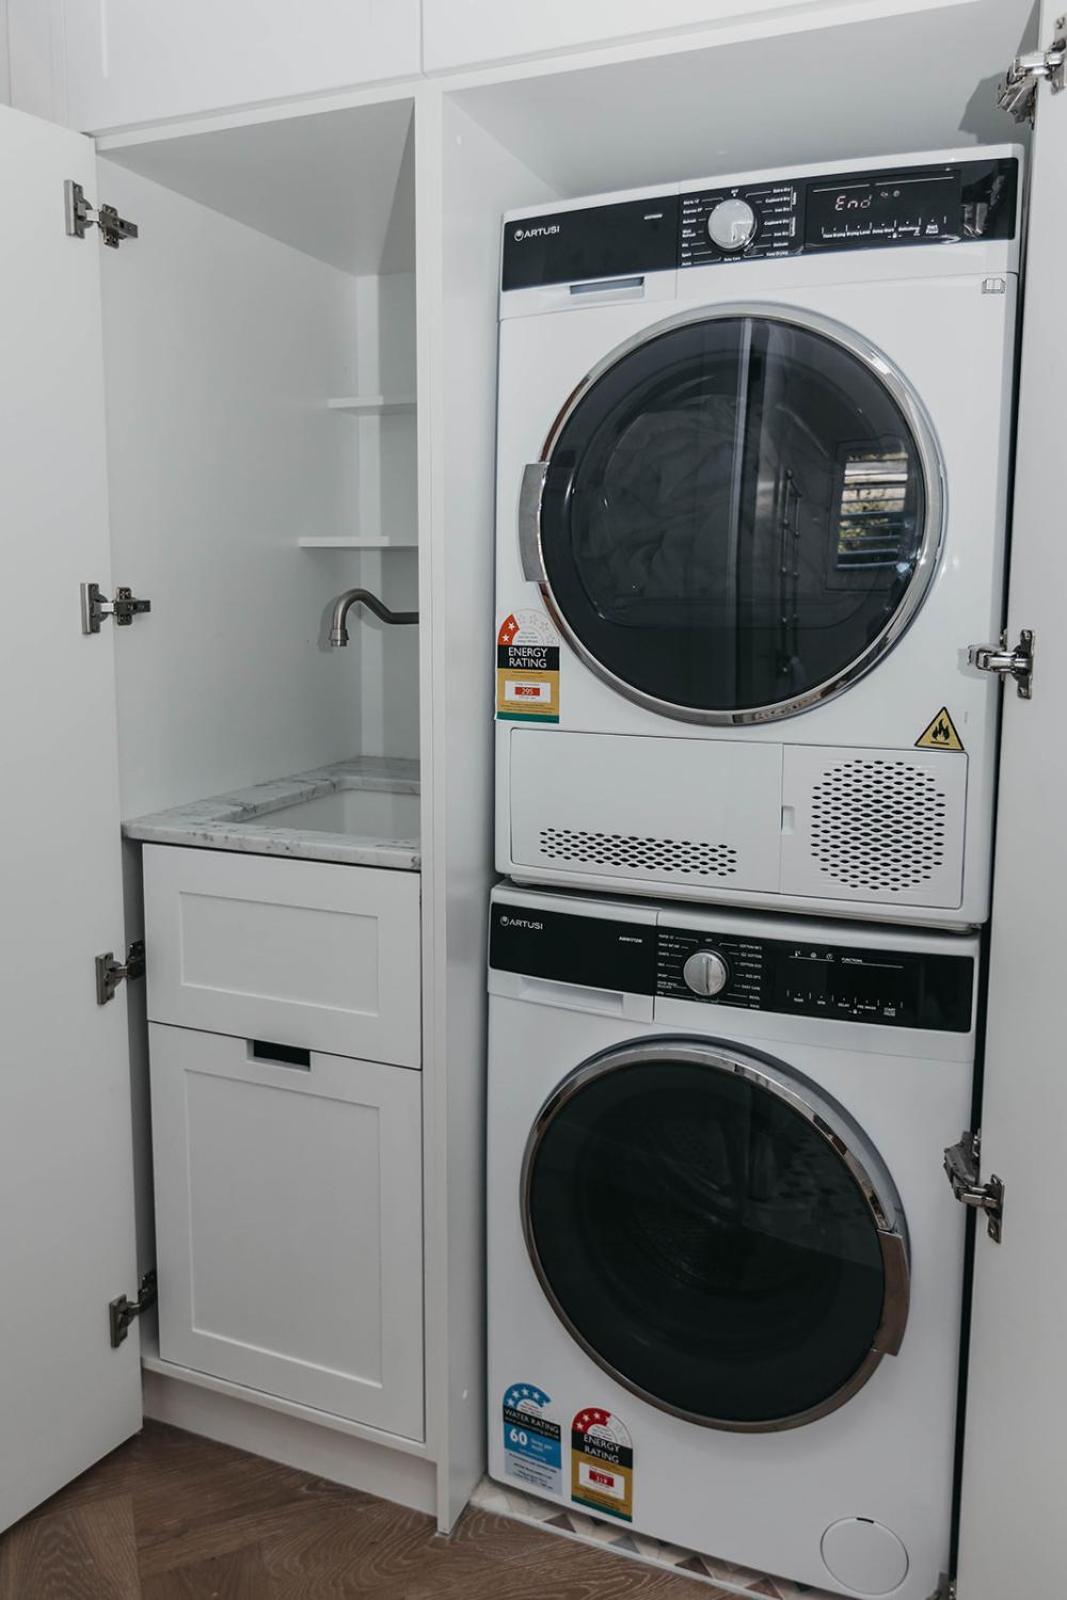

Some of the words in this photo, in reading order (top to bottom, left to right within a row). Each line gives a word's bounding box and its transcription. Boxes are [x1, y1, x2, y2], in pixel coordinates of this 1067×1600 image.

[834, 195, 872, 211] End
[523, 225, 560, 239] ARTUSI
[508, 646, 548, 658] ENERGY
[508, 658, 547, 668] RATING
[509, 919, 544, 930] ARTUSI
[504, 1408, 529, 1422] WATER
[530, 1418, 560, 1434] RATING
[510, 1428, 528, 1446] 60
[583, 1433, 620, 1453] ENERGY
[584, 1445, 620, 1464] RATING
